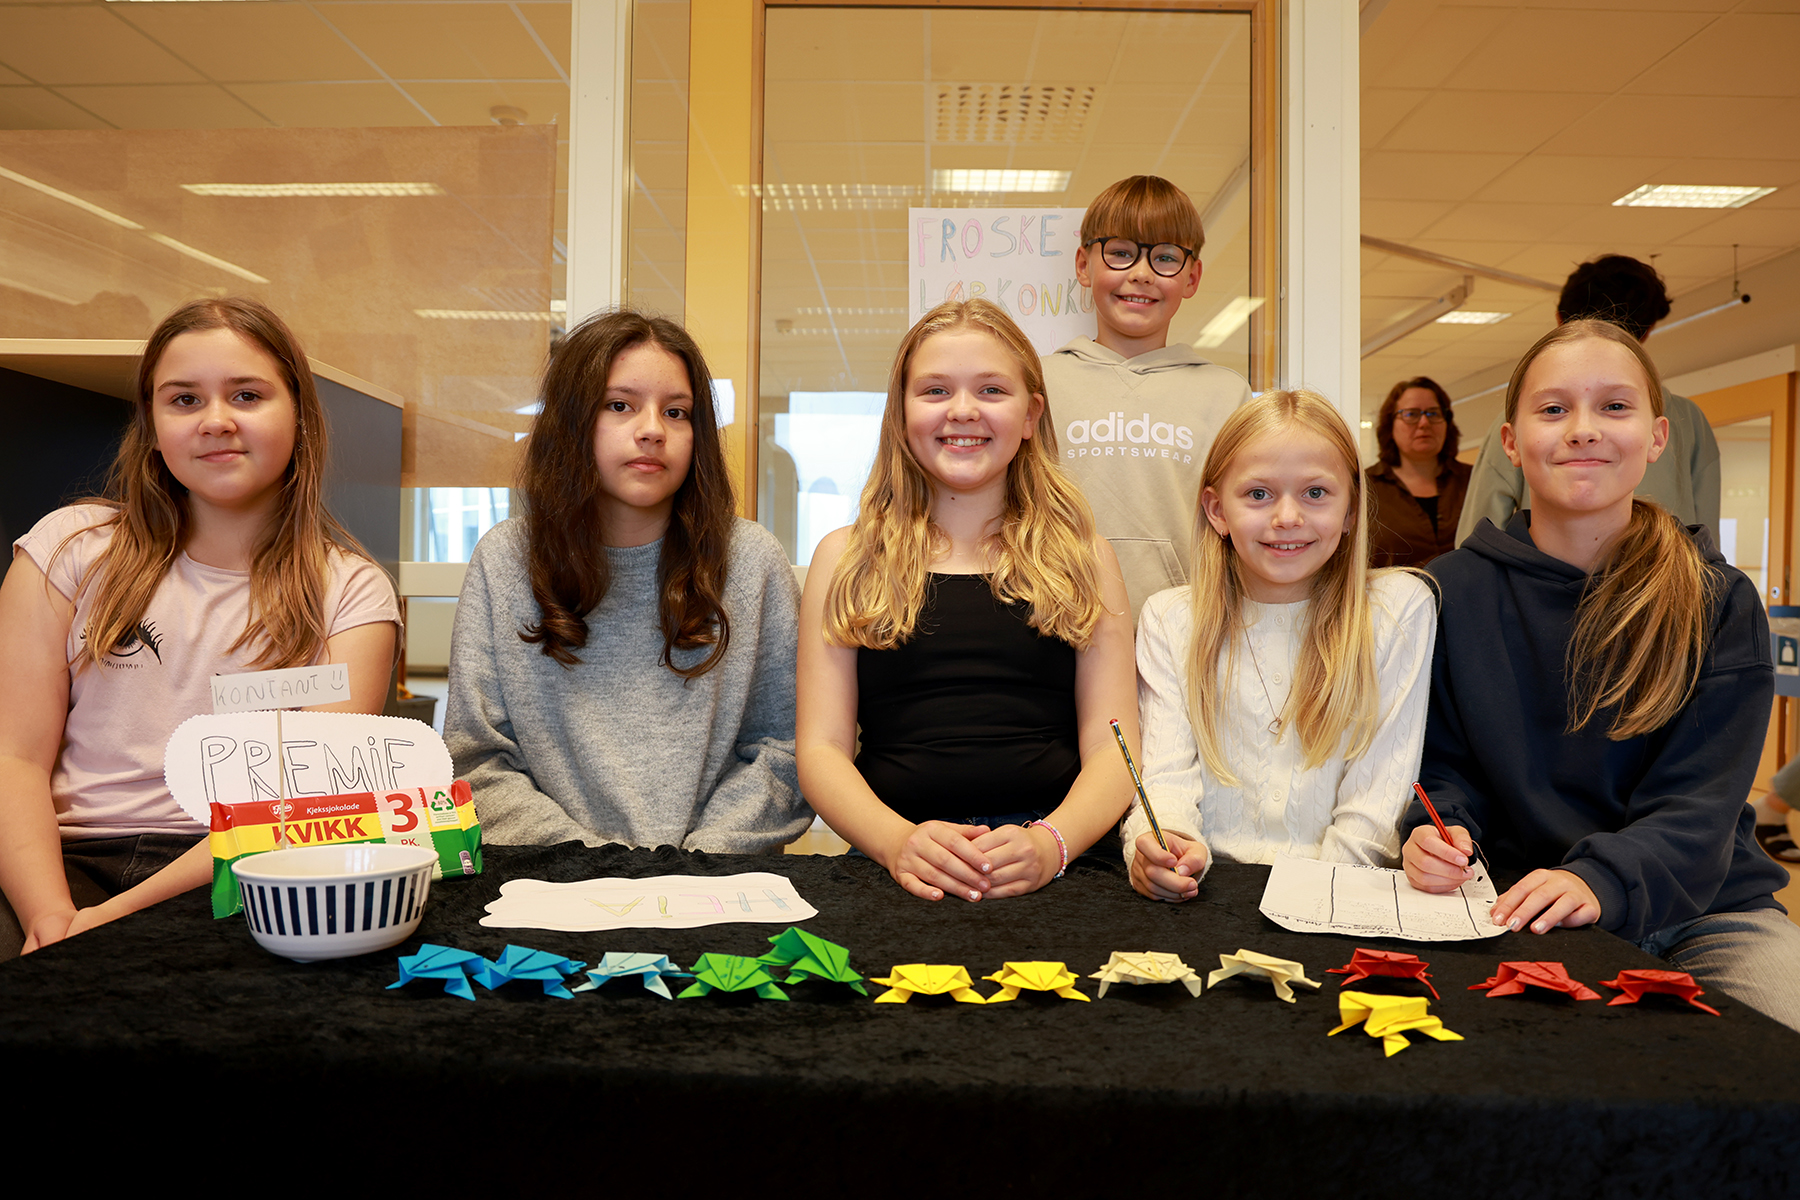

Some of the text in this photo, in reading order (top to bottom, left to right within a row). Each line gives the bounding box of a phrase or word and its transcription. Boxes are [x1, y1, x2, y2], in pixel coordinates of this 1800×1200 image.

[1066, 411, 1194, 450] adidas
[1067, 446, 1192, 464] SPORTSWEAR
[214, 674, 318, 706] KONTANT
[306, 803, 360, 815] Kjekssjokolade
[384, 792, 419, 833] 3
[272, 816, 368, 845] KVIKK
